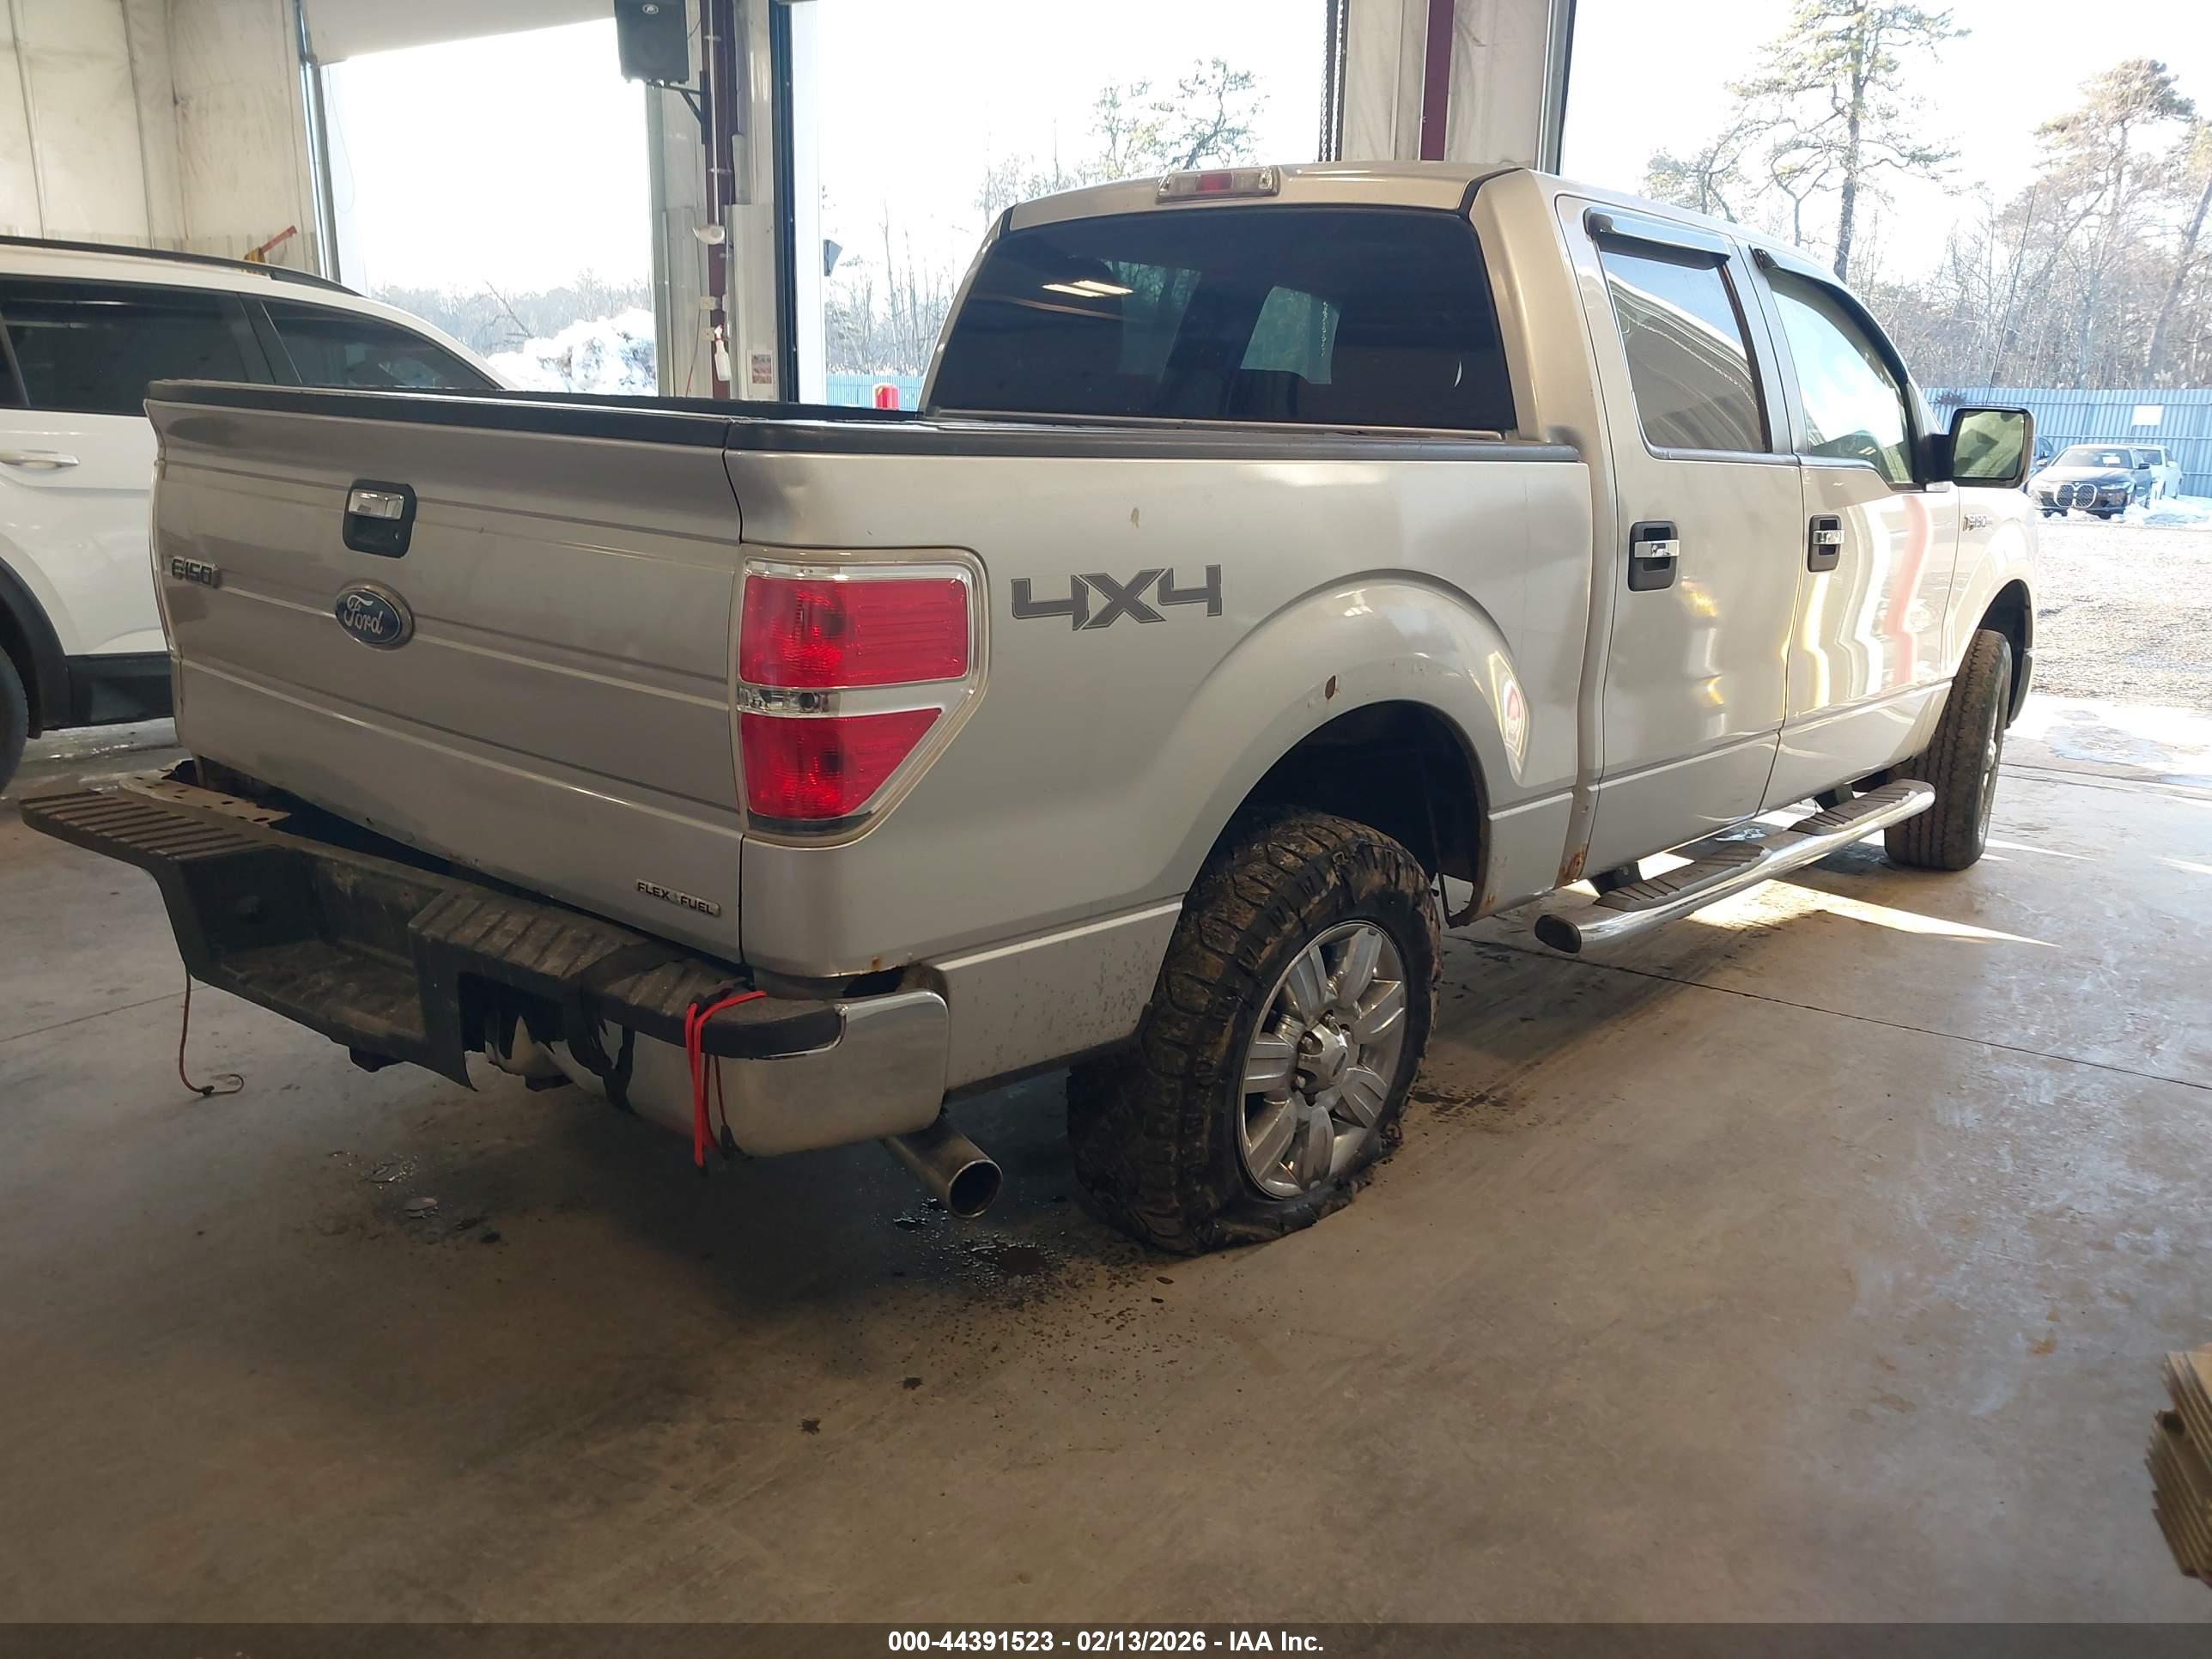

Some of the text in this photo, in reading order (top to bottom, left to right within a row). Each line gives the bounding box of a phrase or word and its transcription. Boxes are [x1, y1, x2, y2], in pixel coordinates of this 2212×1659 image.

[344, 594, 383, 635] Ford
[637, 881, 715, 915] FLEX FUEL
